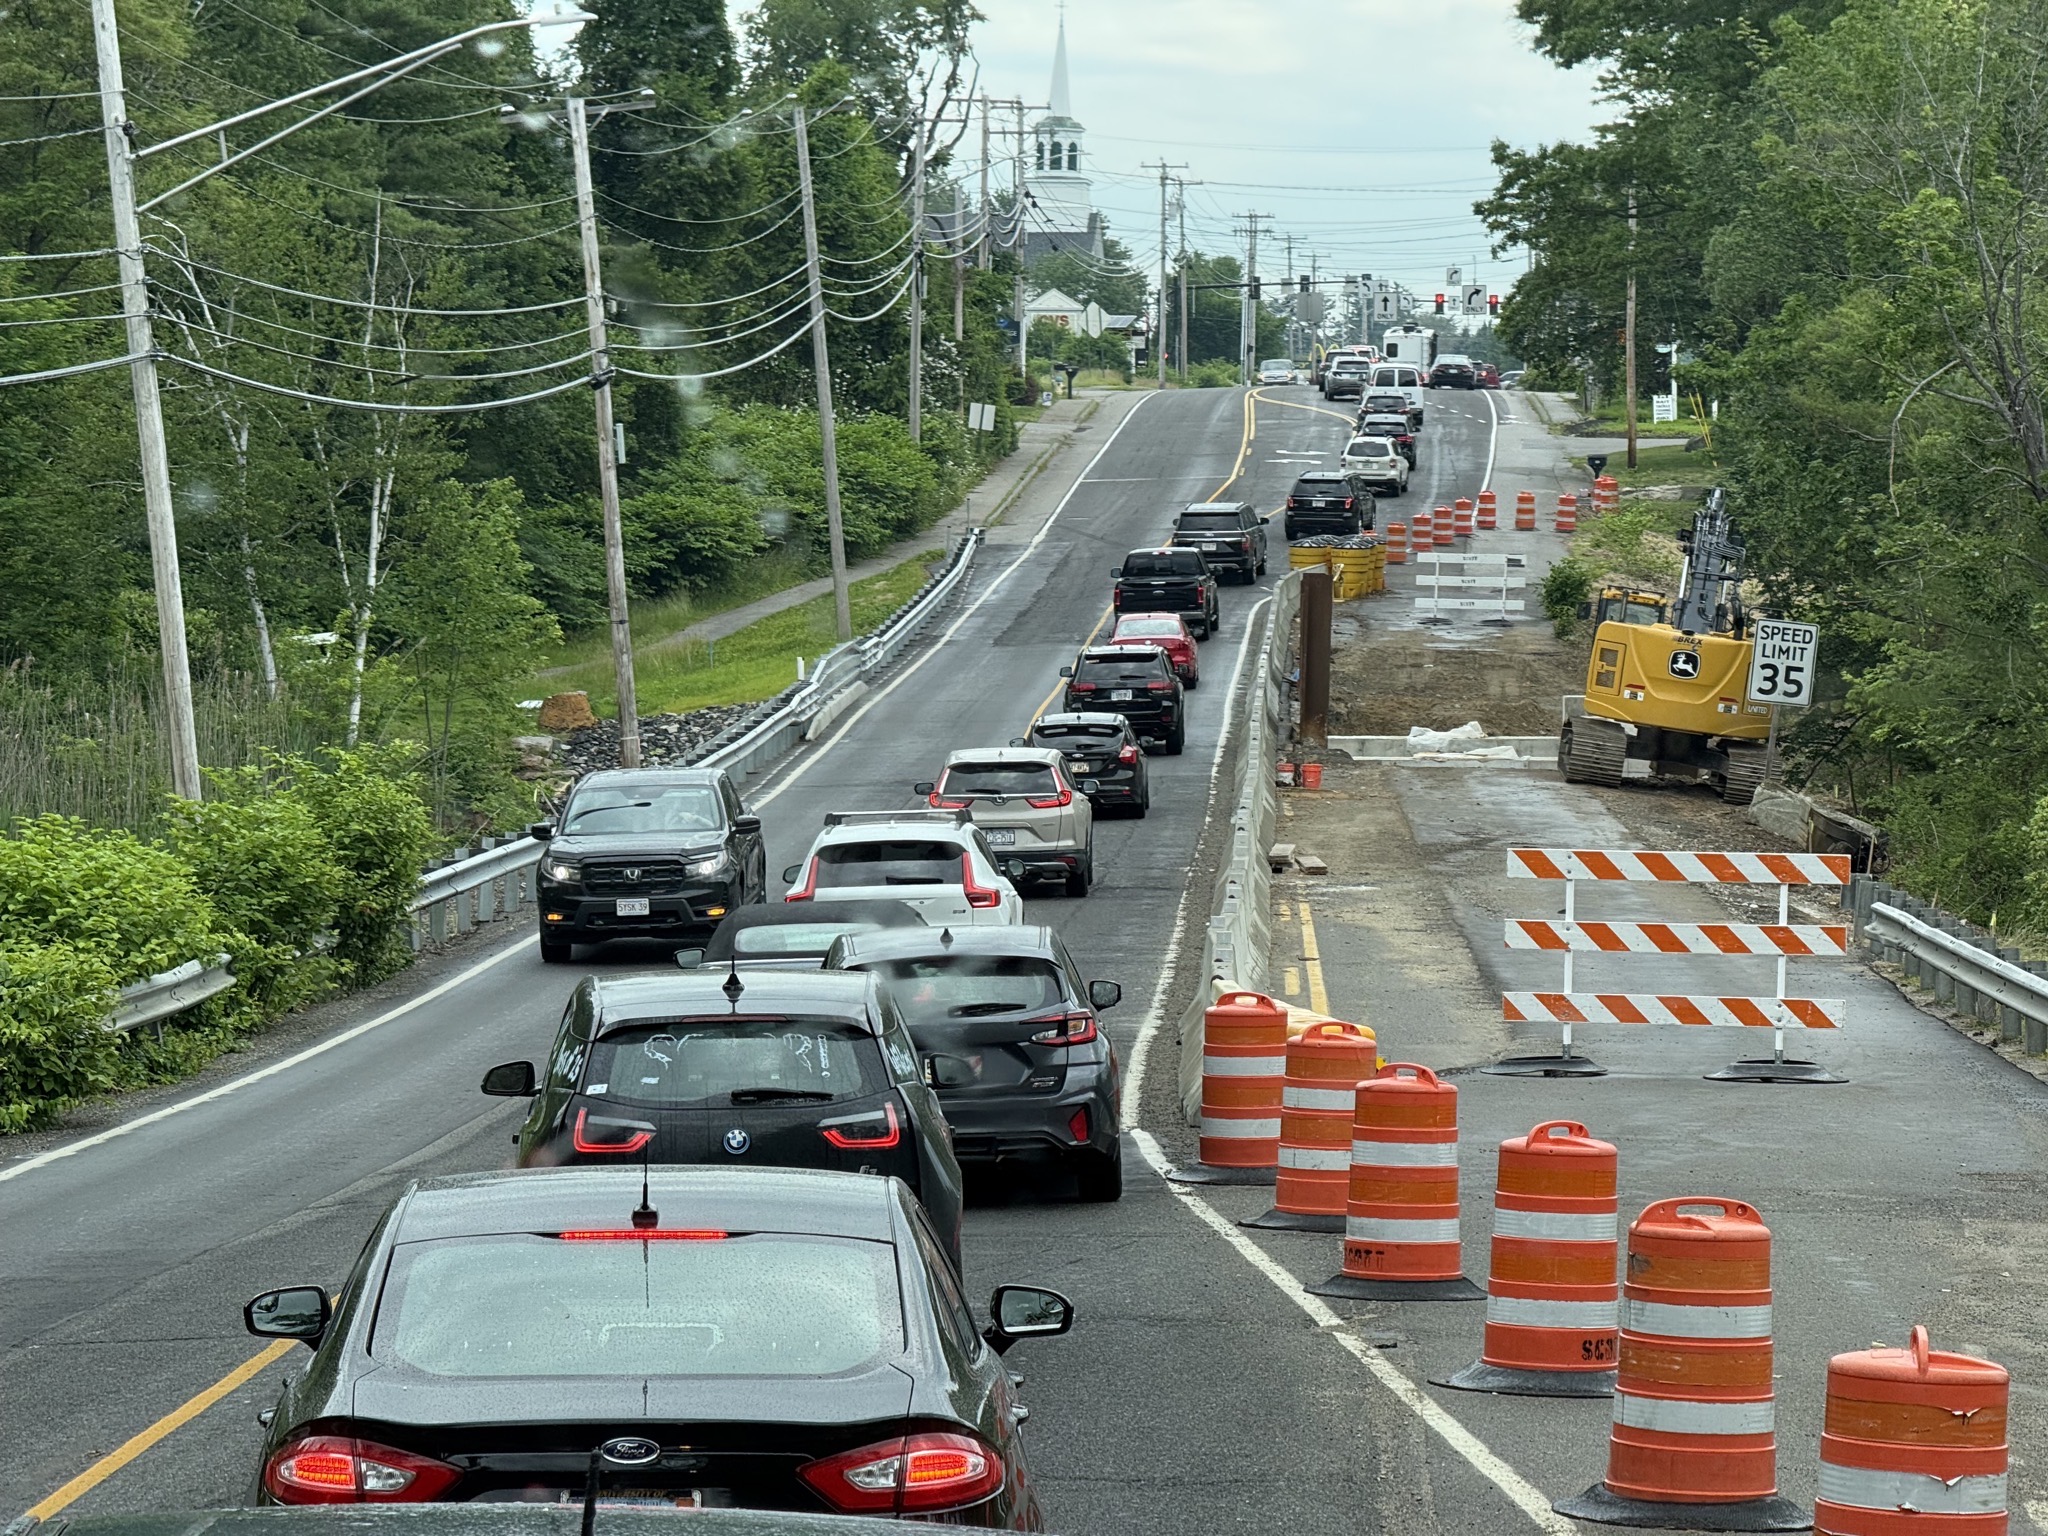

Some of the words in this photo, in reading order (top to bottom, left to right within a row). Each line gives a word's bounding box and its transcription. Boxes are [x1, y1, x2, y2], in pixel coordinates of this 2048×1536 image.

[1677, 636, 1703, 645] BREX
[1760, 625, 1813, 644] SPEED
[1761, 643, 1808, 662] LIMIT
[1756, 663, 1804, 698] 35
[638, 902, 648, 911] 39
[613, 1442, 647, 1457] Ford
